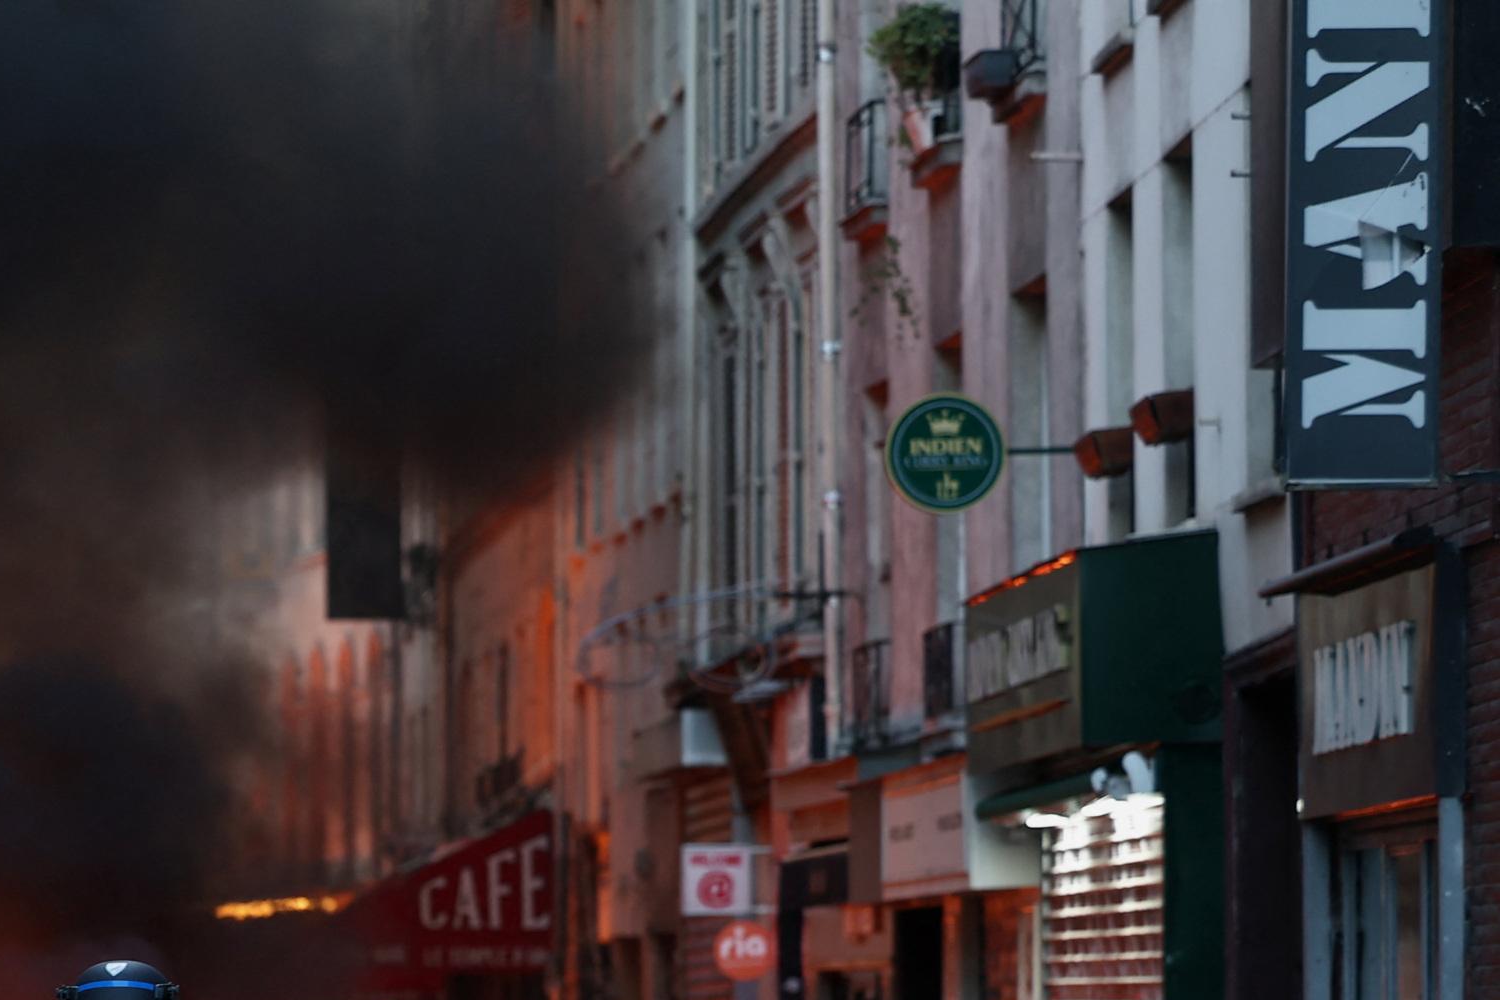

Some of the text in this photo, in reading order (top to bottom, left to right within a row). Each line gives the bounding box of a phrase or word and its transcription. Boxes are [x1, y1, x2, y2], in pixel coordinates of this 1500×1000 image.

[909, 437, 984, 456] INDIEN
[418, 834, 552, 930] CAFE
[720, 925, 767, 959] ria
